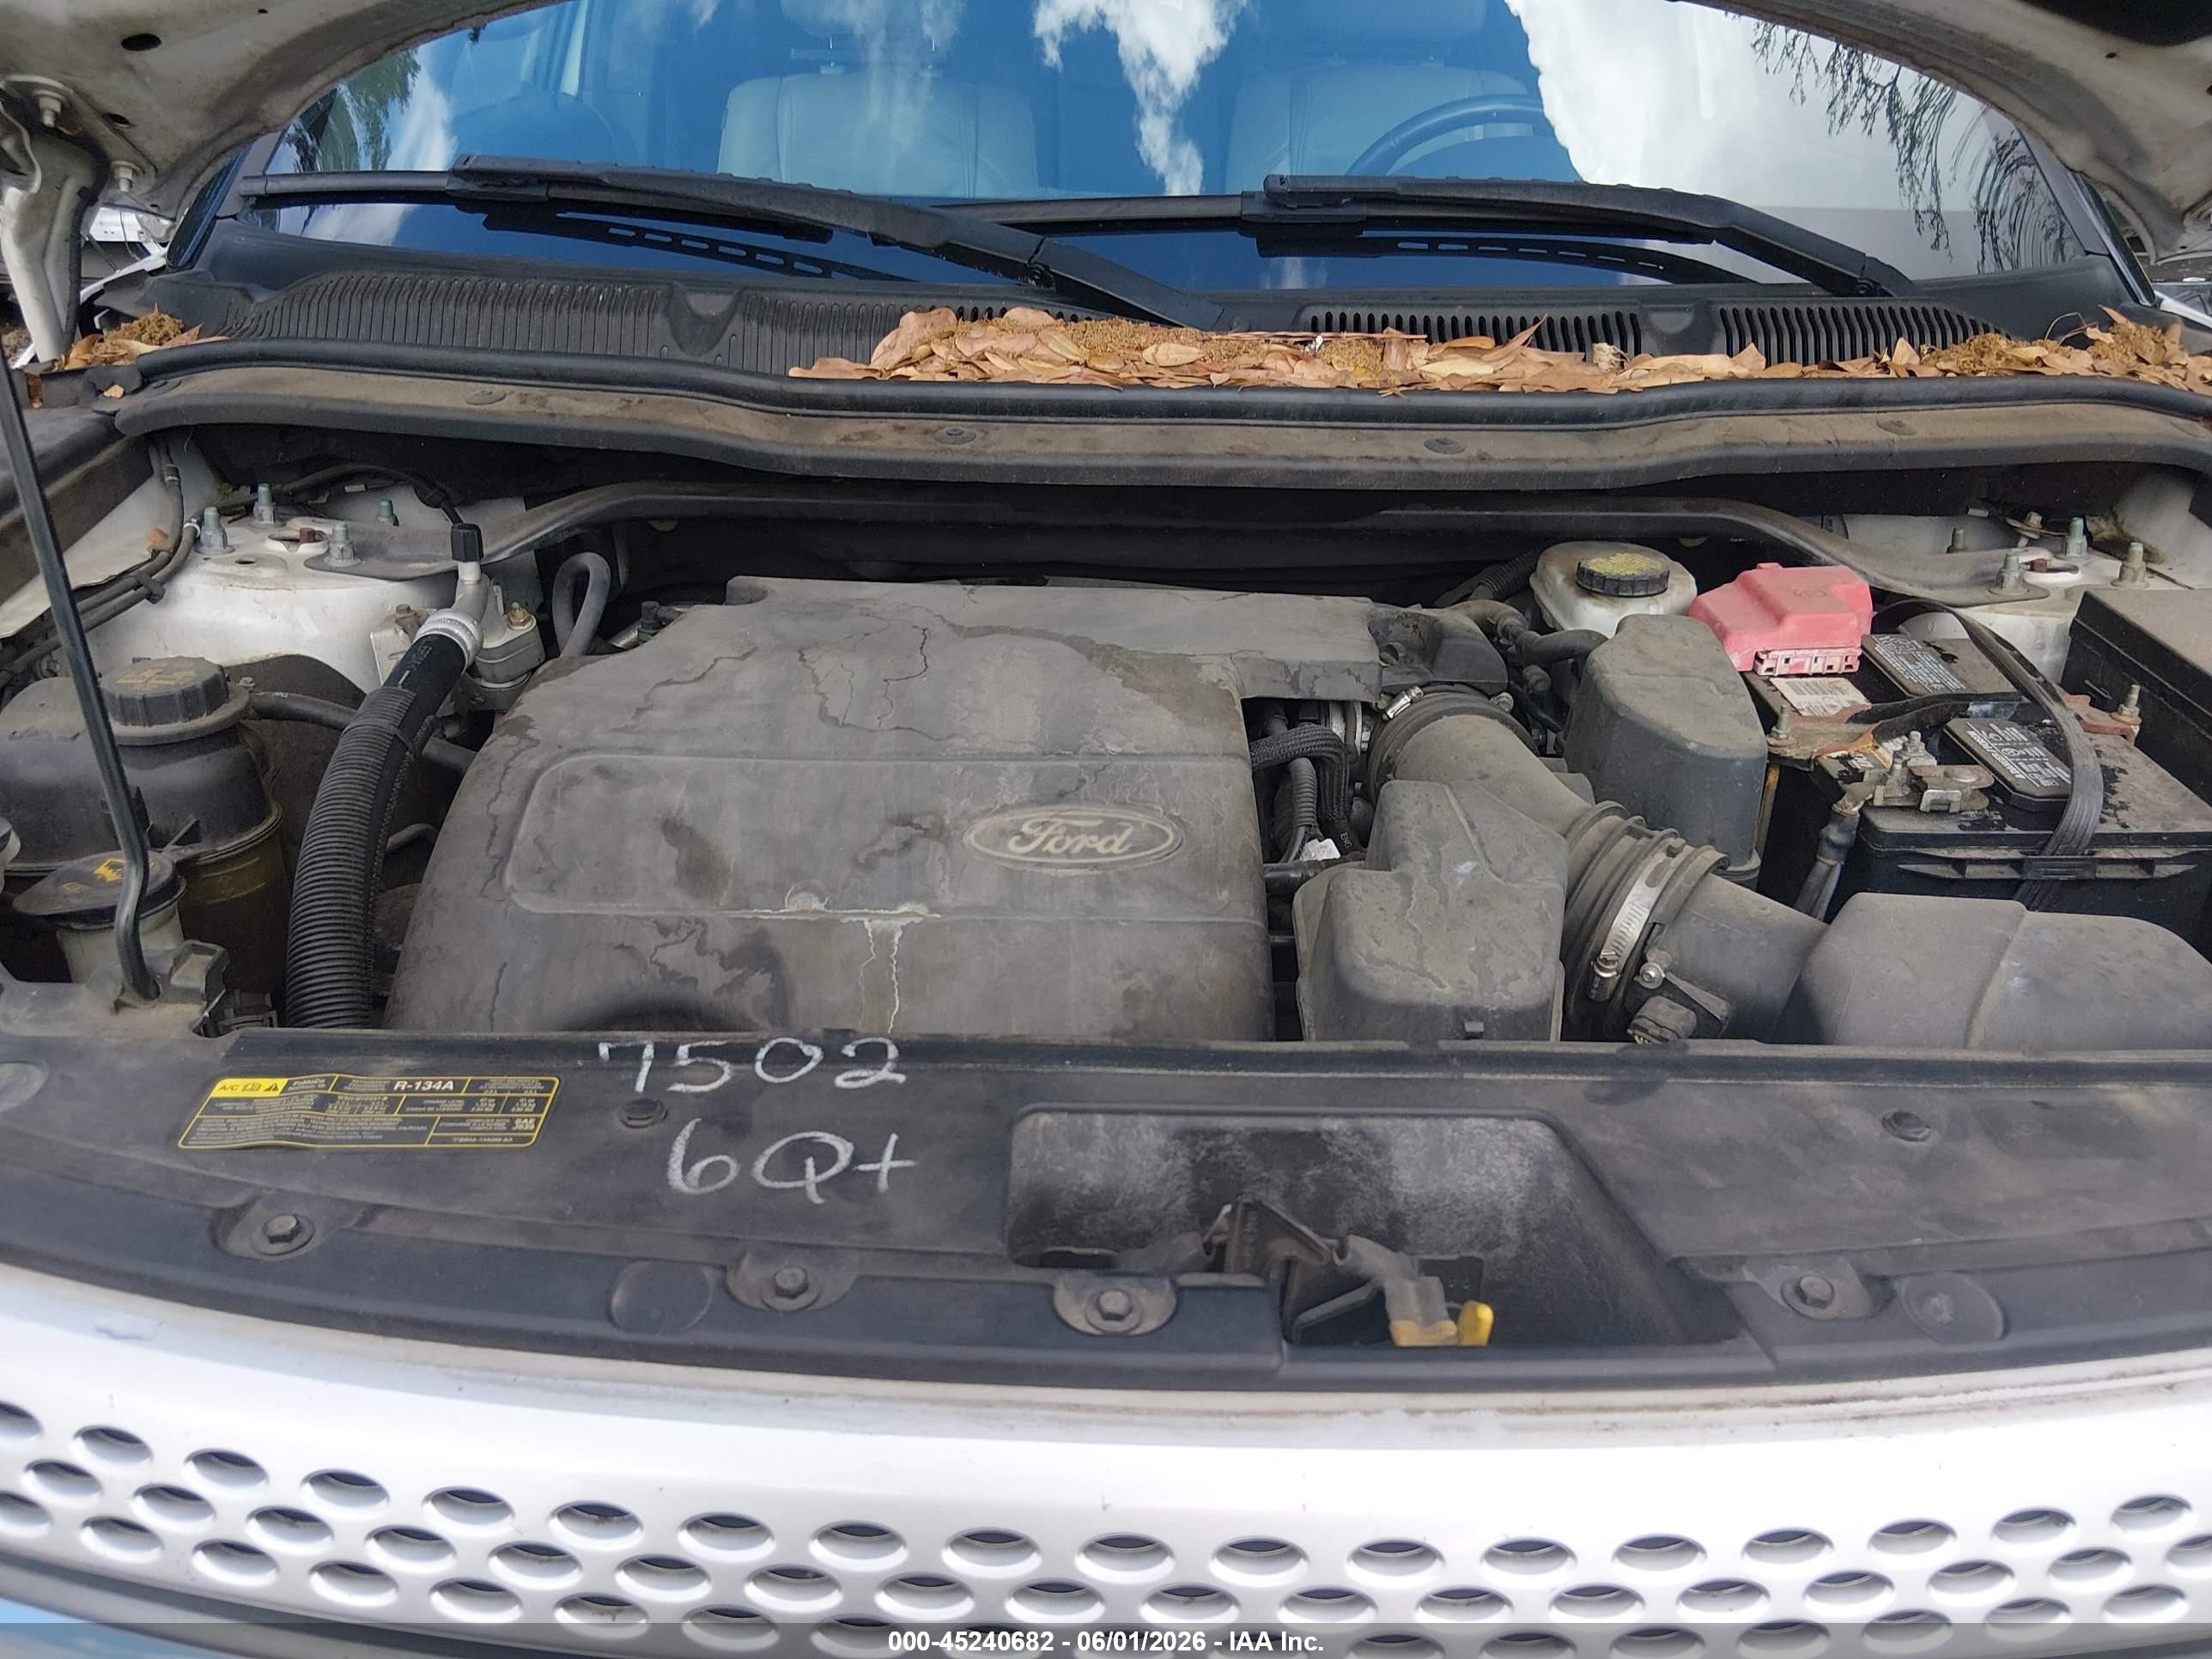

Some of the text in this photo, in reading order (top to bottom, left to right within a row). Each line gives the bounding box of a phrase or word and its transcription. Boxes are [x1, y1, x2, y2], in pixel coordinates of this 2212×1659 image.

[1007, 818, 1134, 854] Ford
[599, 1037, 907, 1092] 7502
[393, 1080, 454, 1091] R-134A
